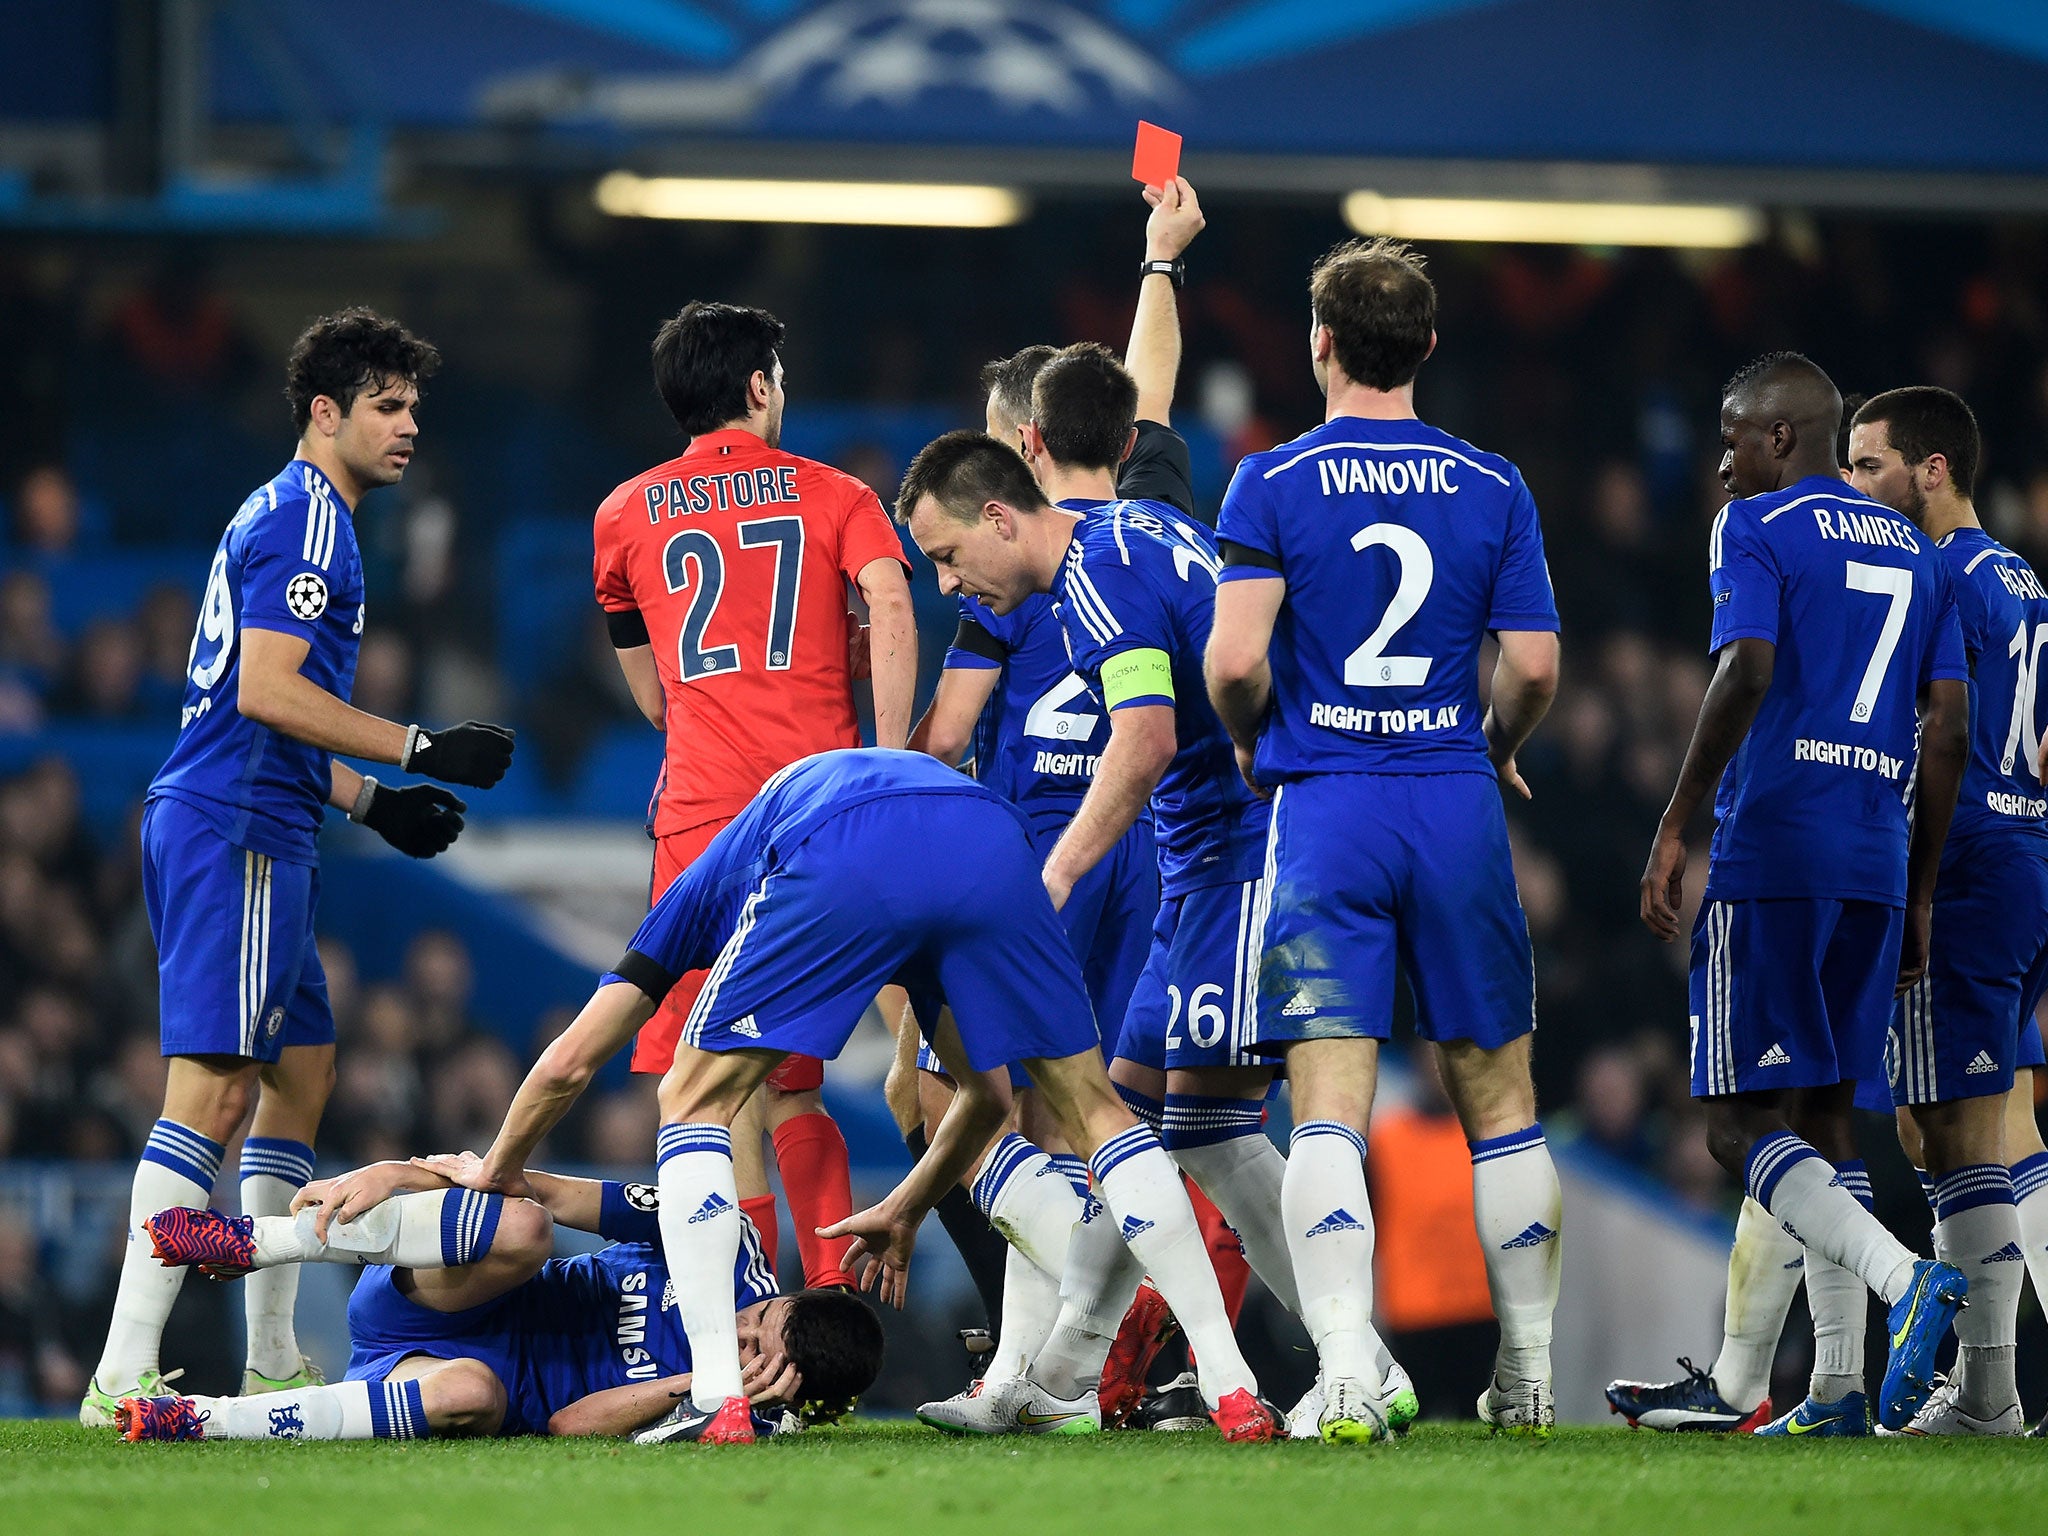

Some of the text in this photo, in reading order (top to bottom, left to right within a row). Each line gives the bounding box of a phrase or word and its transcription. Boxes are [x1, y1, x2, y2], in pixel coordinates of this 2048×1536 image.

[1317, 457, 1459, 496] IVANOVIC
[645, 466, 800, 525] PASTORE
[1813, 508, 1920, 555] RAMIRES
[662, 515, 805, 683] 27
[1343, 522, 1433, 687] 2
[1846, 560, 1913, 723] 7
[1310, 702, 1461, 734] RIGHT TO PLAY
[1033, 750, 1084, 777] RIGHT
[1795, 739, 1852, 767] RIGHT
[1853, 746, 1877, 771] TO
[1165, 983, 1226, 1050] 26
[1281, 1005, 1316, 1017] adidas
[1757, 1054, 1791, 1068] adidas
[1965, 1061, 1999, 1075] adidas
[687, 1203, 734, 1224] adidas
[1305, 1222, 1365, 1238] adidas
[1500, 1229, 1558, 1250] adidas
[617, 1271, 658, 1380] SAMSU
